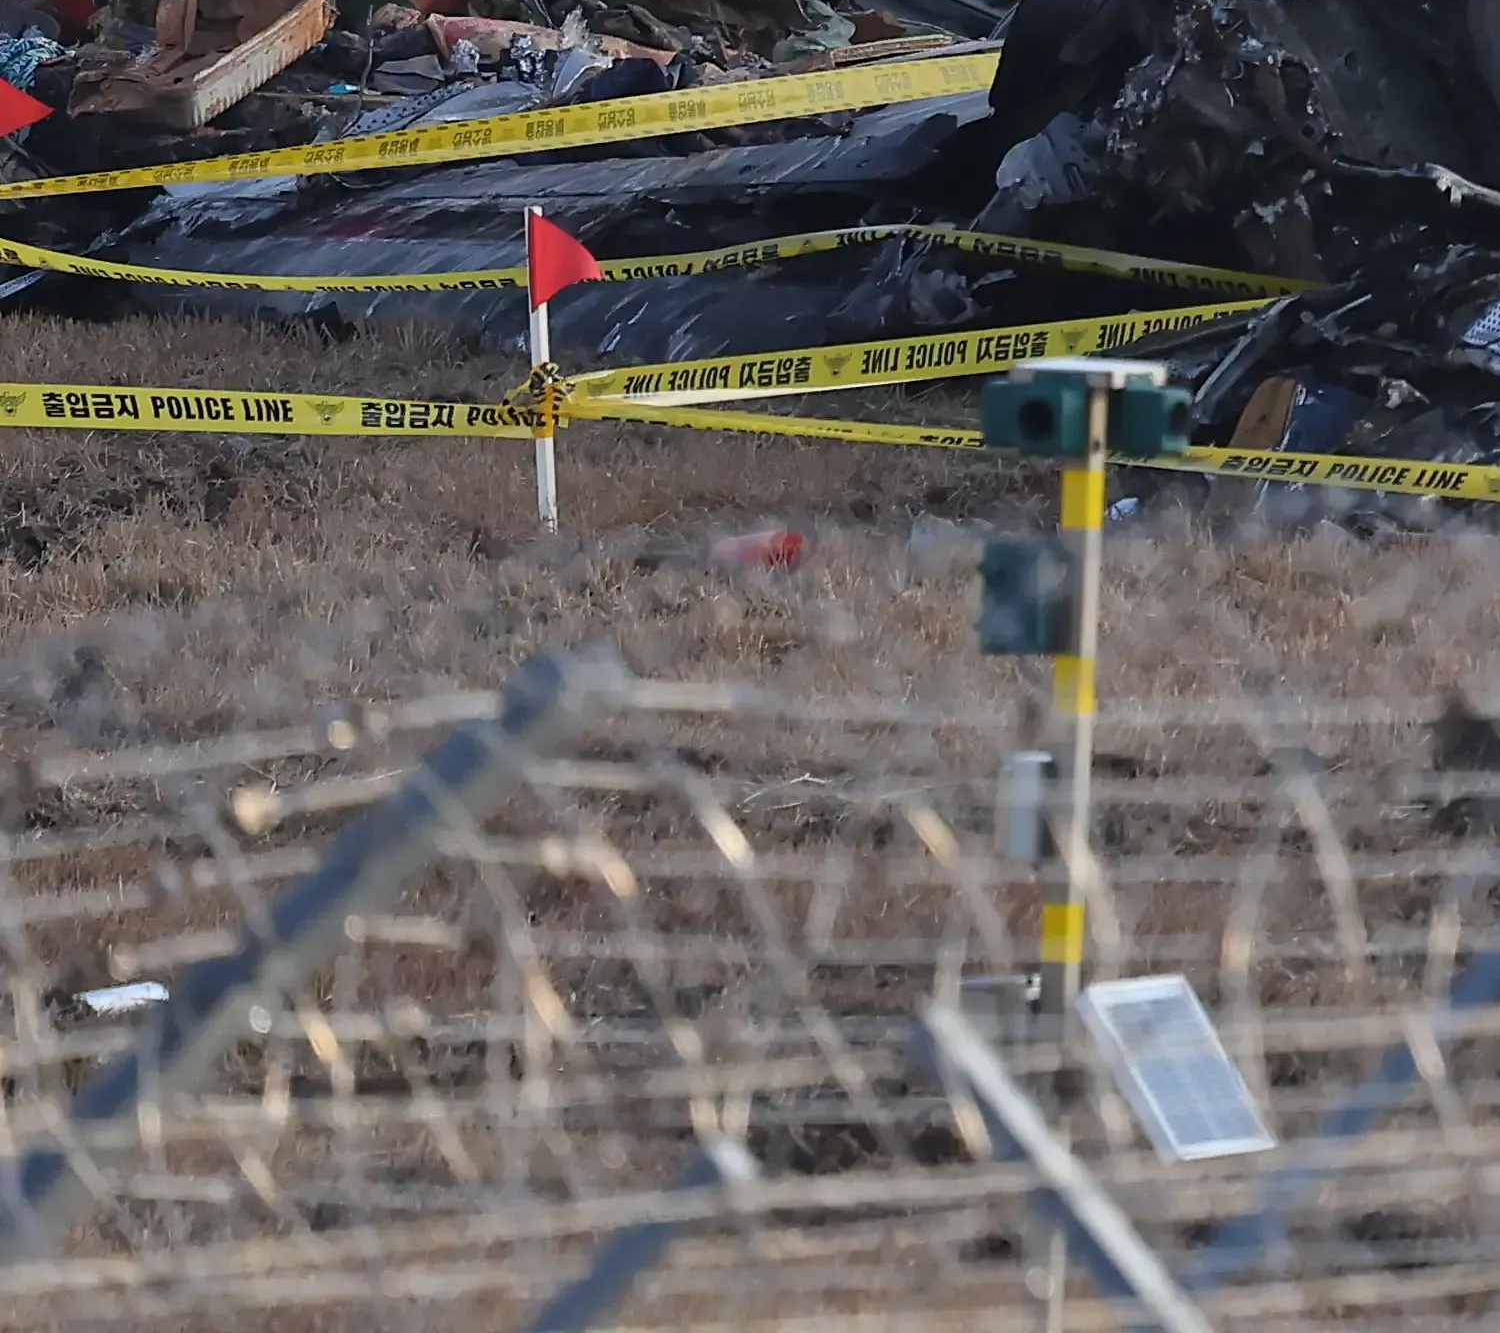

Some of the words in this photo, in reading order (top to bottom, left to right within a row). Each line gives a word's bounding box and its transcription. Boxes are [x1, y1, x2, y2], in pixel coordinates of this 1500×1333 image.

[43, 391, 140, 421] 출입금지
[151, 395, 236, 423] POLICE
[240, 398, 295, 424] LINE
[360, 400, 455, 430] 출입금지
[1220, 454, 1319, 477] 출입금지
[1324, 462, 1410, 485] POLICE
[1412, 468, 1469, 492] LINE
